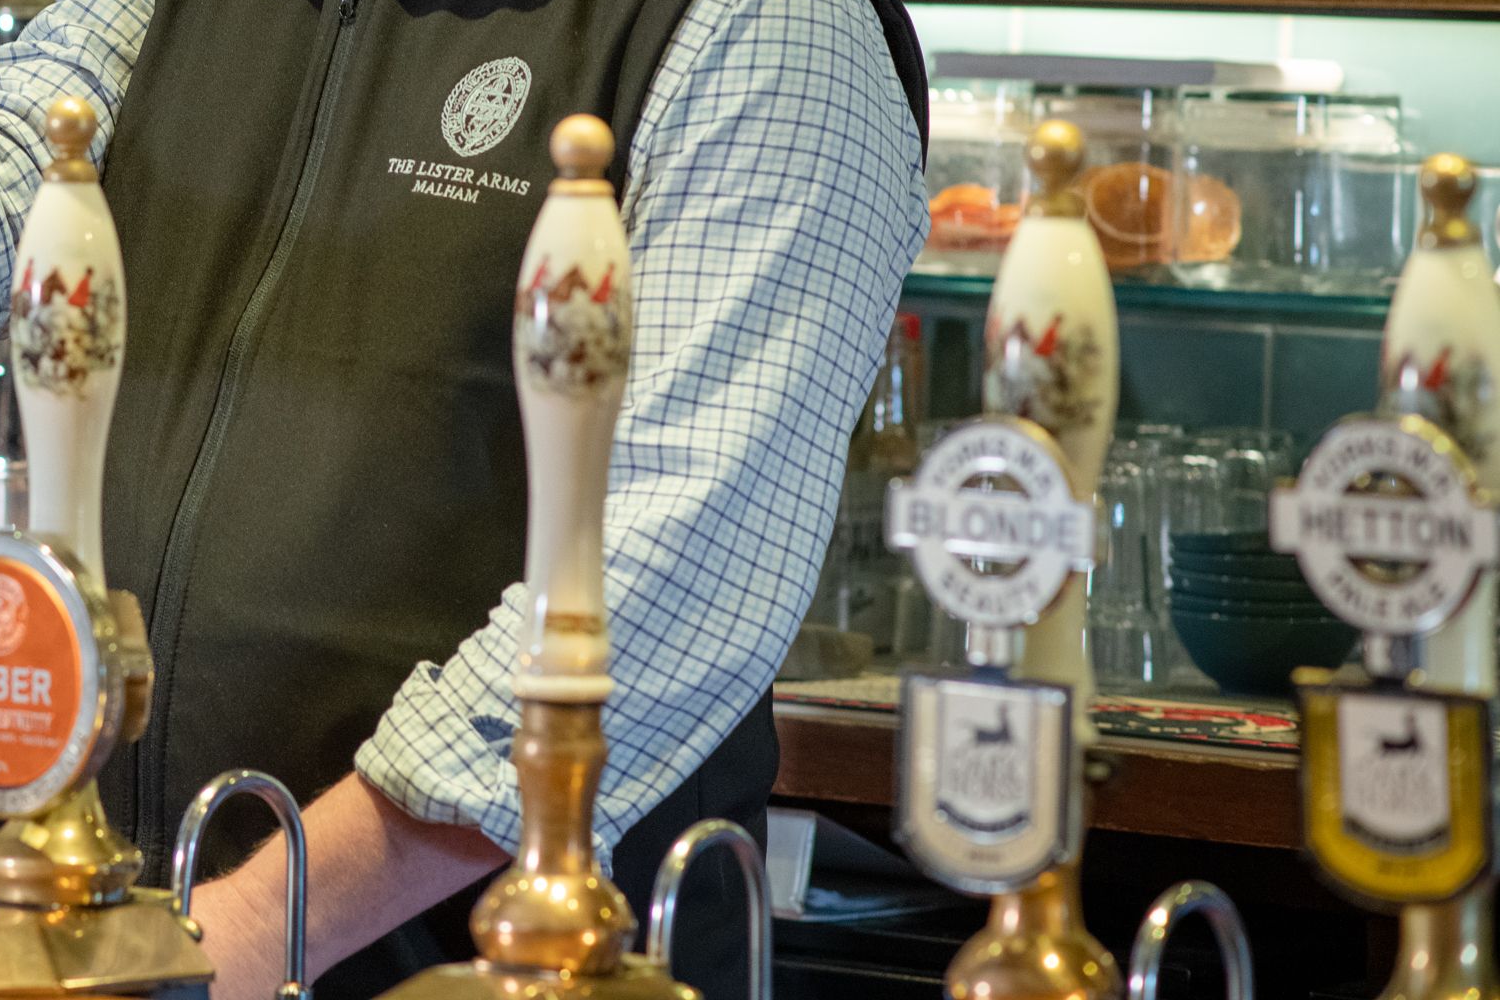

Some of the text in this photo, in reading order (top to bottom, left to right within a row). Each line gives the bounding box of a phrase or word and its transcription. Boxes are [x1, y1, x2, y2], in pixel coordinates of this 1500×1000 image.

[388, 158, 531, 196] THE LISTER ARMS
[411, 179, 480, 204] MALHAM
[910, 503, 1077, 550] BLONDE
[1301, 507, 1472, 549] HETTON
